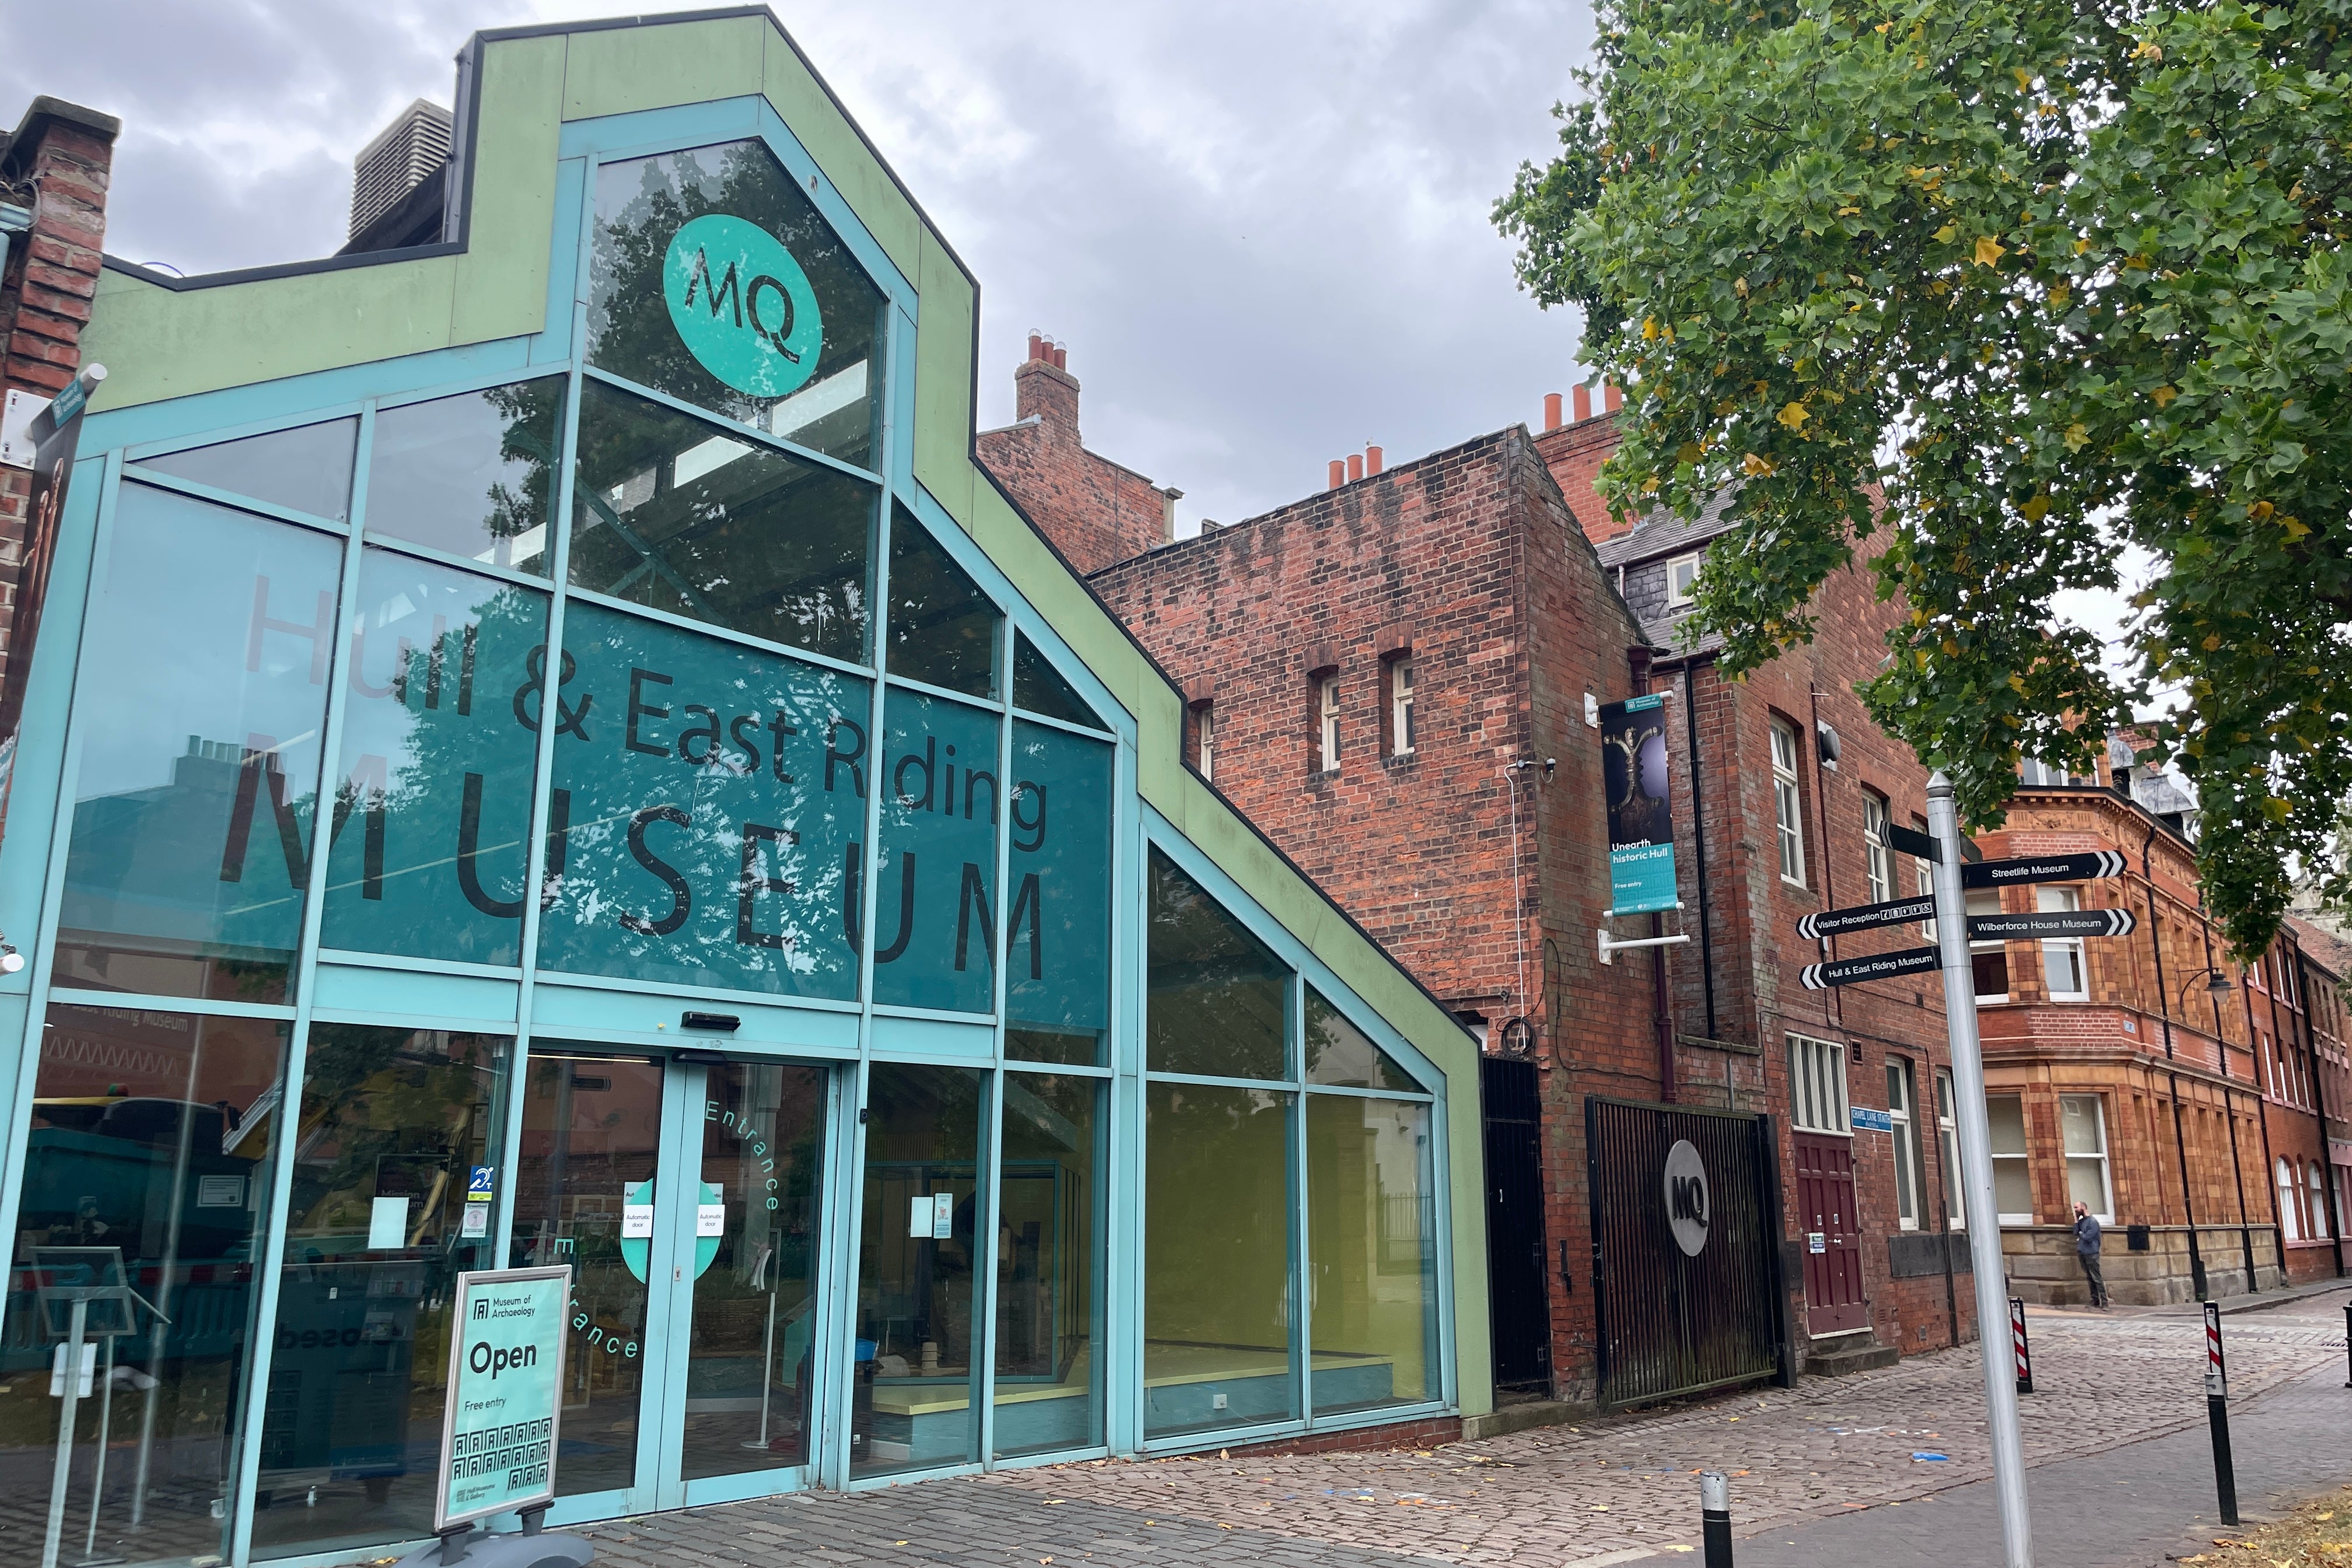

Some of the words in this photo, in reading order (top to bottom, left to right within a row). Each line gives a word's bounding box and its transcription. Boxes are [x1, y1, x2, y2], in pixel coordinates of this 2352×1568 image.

[685, 246, 800, 365] MQ
[245, 575, 478, 717] Hull
[512, 643, 593, 741] &
[625, 667, 796, 784] East
[1612, 838, 1651, 852] Unearth
[219, 732, 1041, 980] MUSEUM
[1612, 850, 1648, 864] historic
[1649, 847, 1668, 859] Hull
[1992, 867, 2029, 878] Streetlife
[2032, 864, 2069, 874] Museum
[1817, 919, 1840, 929] Visitor
[1842, 912, 1880, 925] Reception
[1977, 921, 2028, 932] Wilberforce
[2031, 921, 2060, 929] House
[2062, 919, 2101, 929] Museum
[1828, 968, 1843, 978] Hull
[1845, 967, 1852, 976] &
[1853, 965, 1871, 974] East
[1872, 961, 1896, 971] Riding
[1898, 956, 1933, 967] Museum
[705, 1100, 779, 1210] Entrance
[1672, 1175, 1708, 1228] MQ
[493, 1297, 522, 1307] Museum
[523, 1294, 532, 1304] of
[554, 1238, 638, 1358] Erance
[492, 1307, 536, 1319] Archaeology
[470, 1341, 537, 1380] Open
[464, 1400, 484, 1412] Free
[485, 1396, 507, 1408] entry
